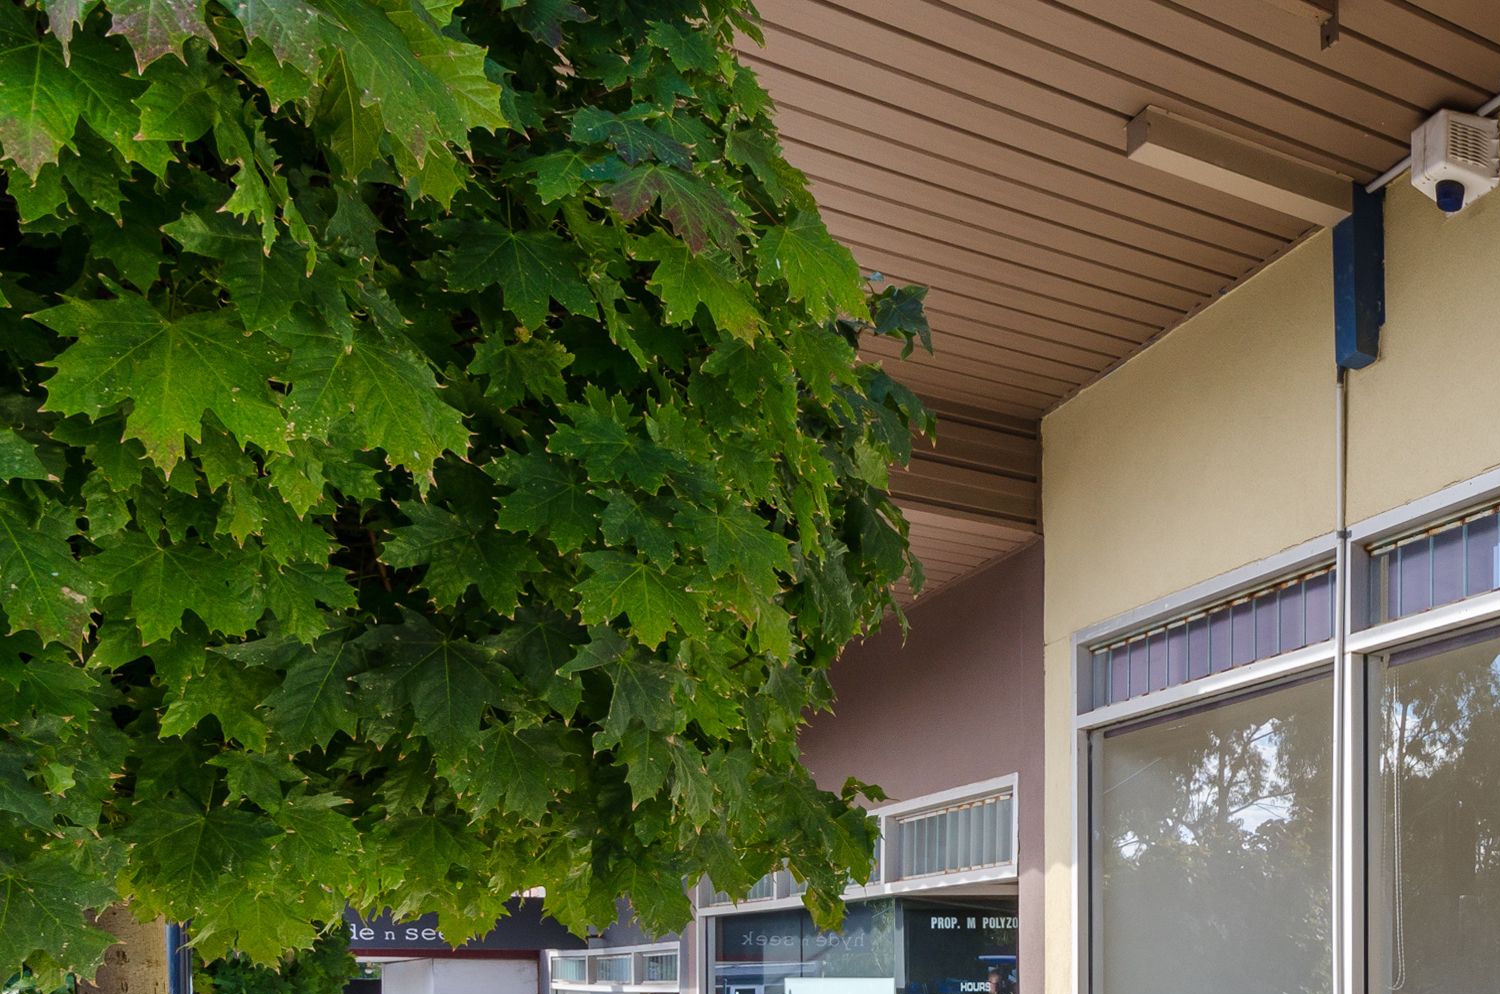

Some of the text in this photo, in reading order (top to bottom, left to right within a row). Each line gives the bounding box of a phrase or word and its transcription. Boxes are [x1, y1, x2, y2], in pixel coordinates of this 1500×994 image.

[930, 917, 1018, 929] PROP. M POLYZO
[384, 930, 396, 941] n
[960, 981, 992, 992] HOURS
